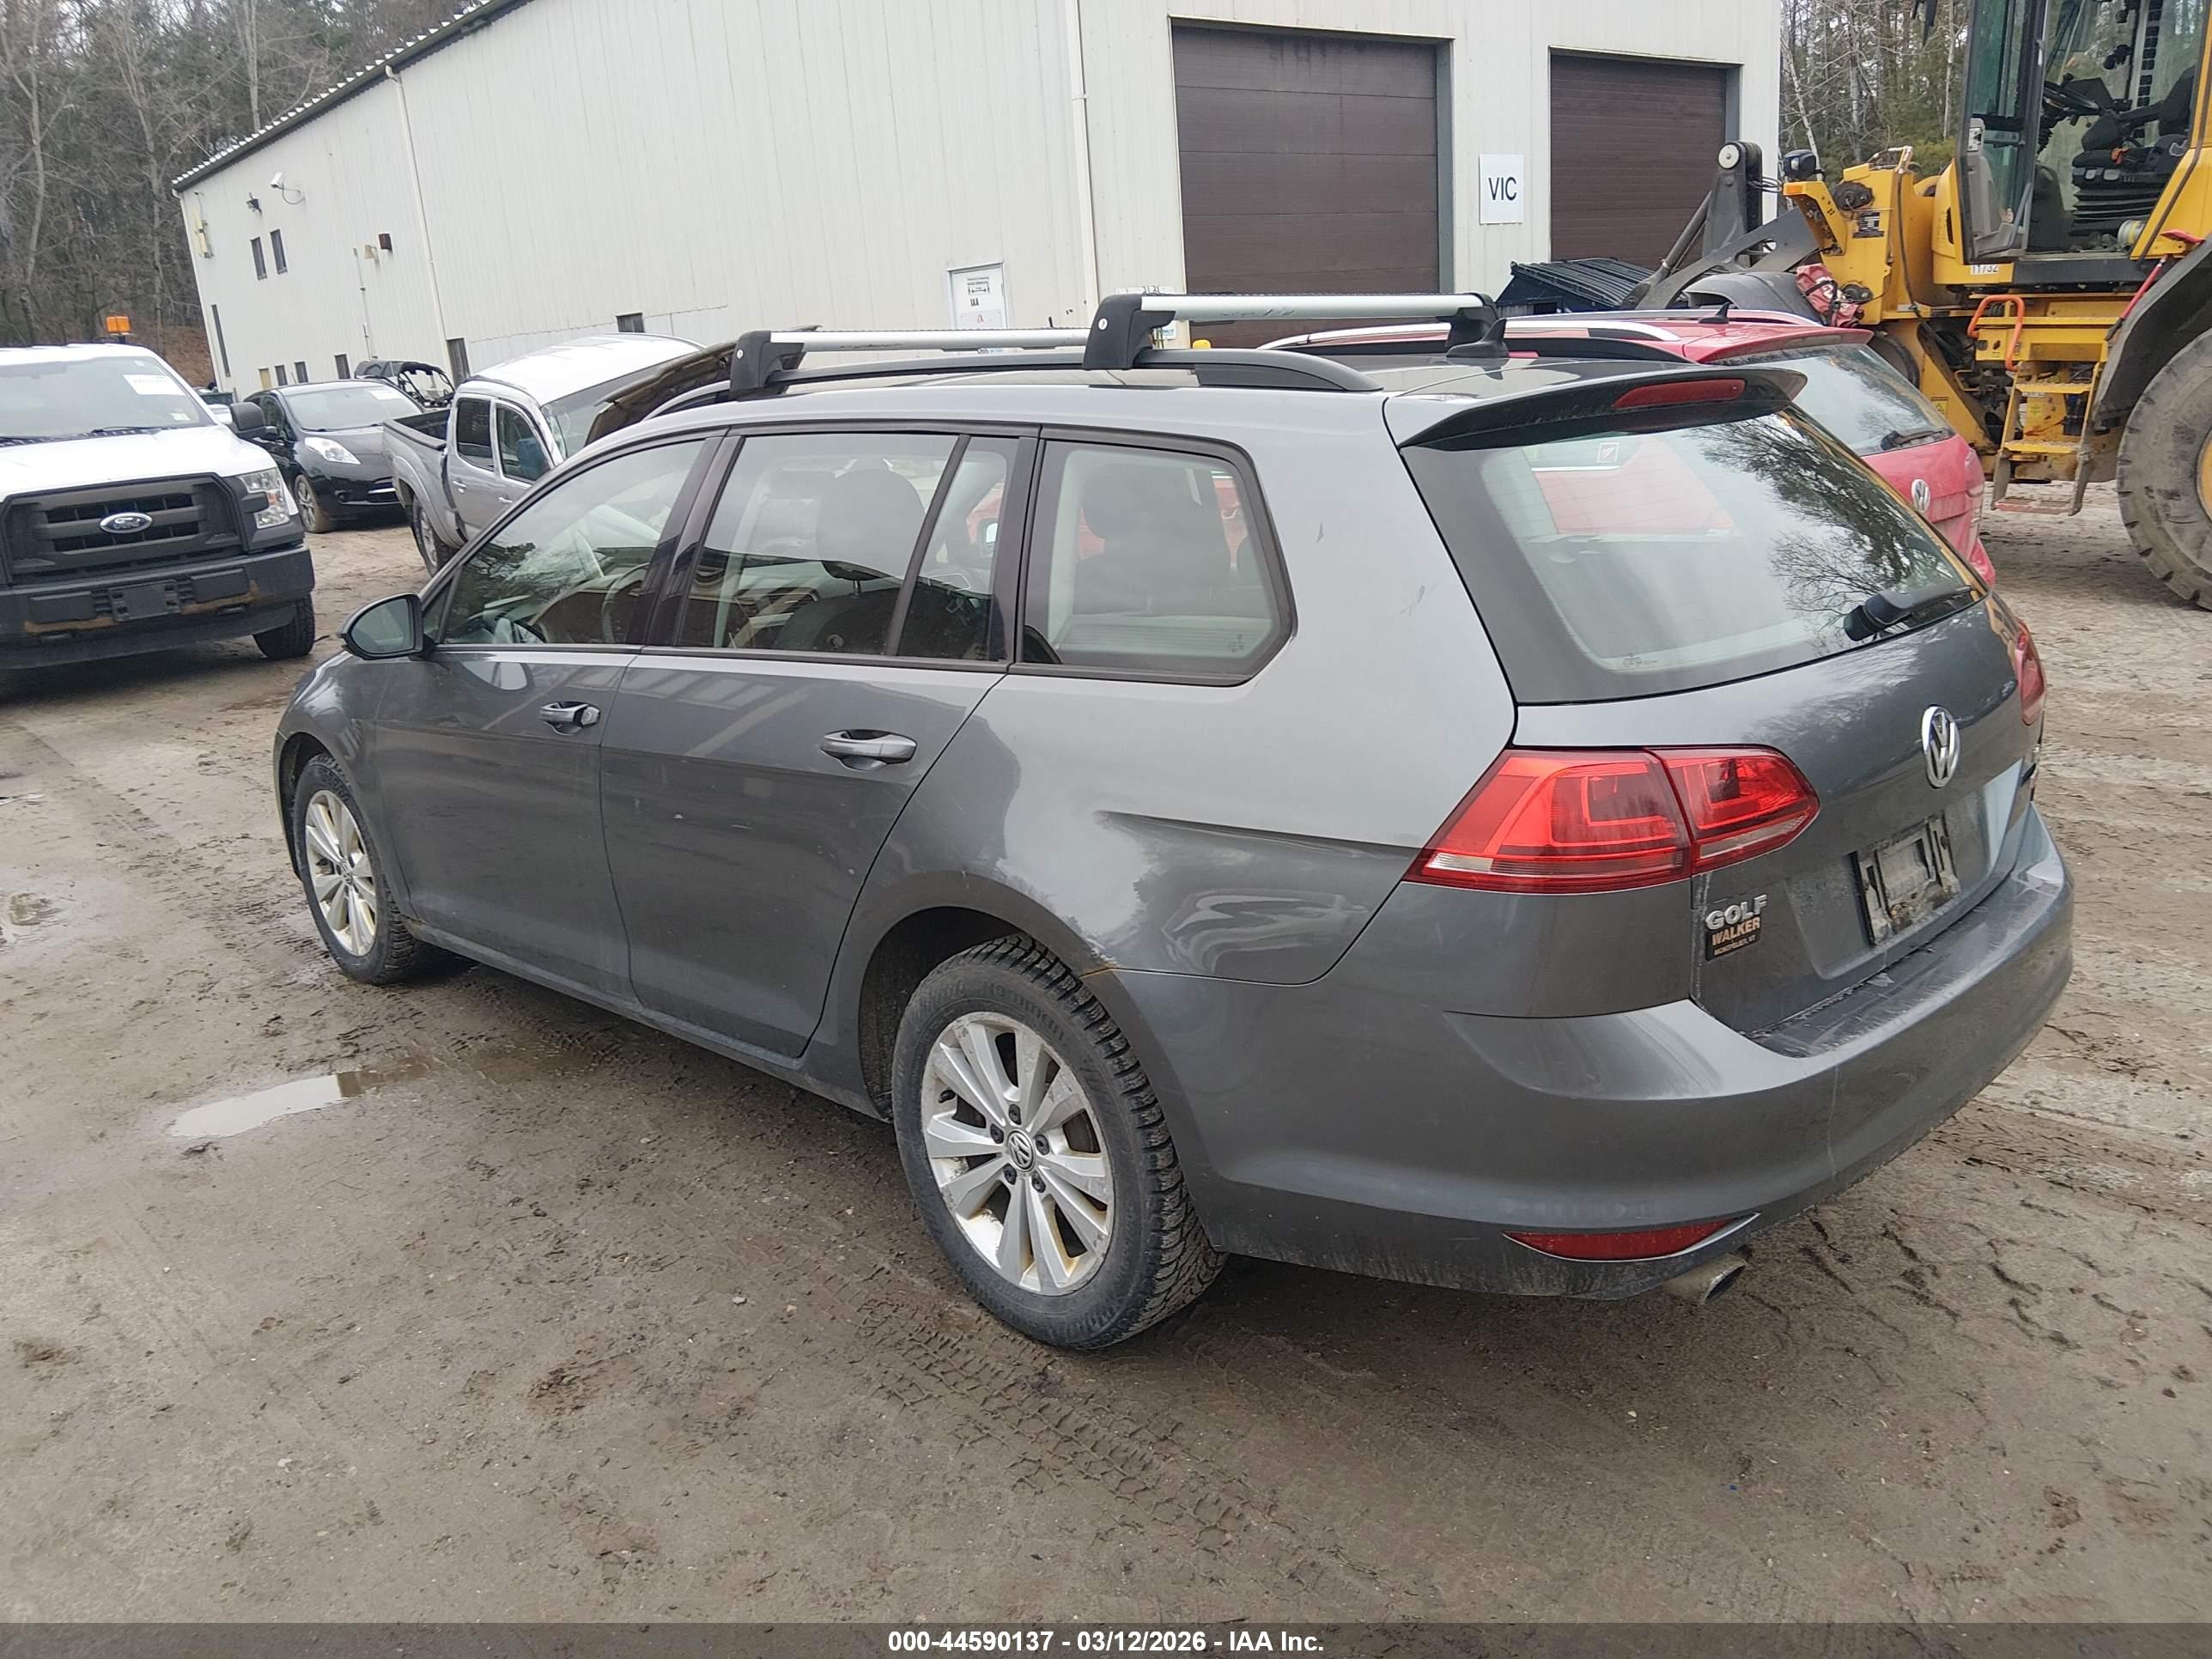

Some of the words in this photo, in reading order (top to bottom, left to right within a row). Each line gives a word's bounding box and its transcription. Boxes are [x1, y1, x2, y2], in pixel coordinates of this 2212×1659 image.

[1488, 176, 1517, 201] VIC
[1705, 894, 1767, 930] GOLF
[1712, 917, 1759, 945] WALKER
